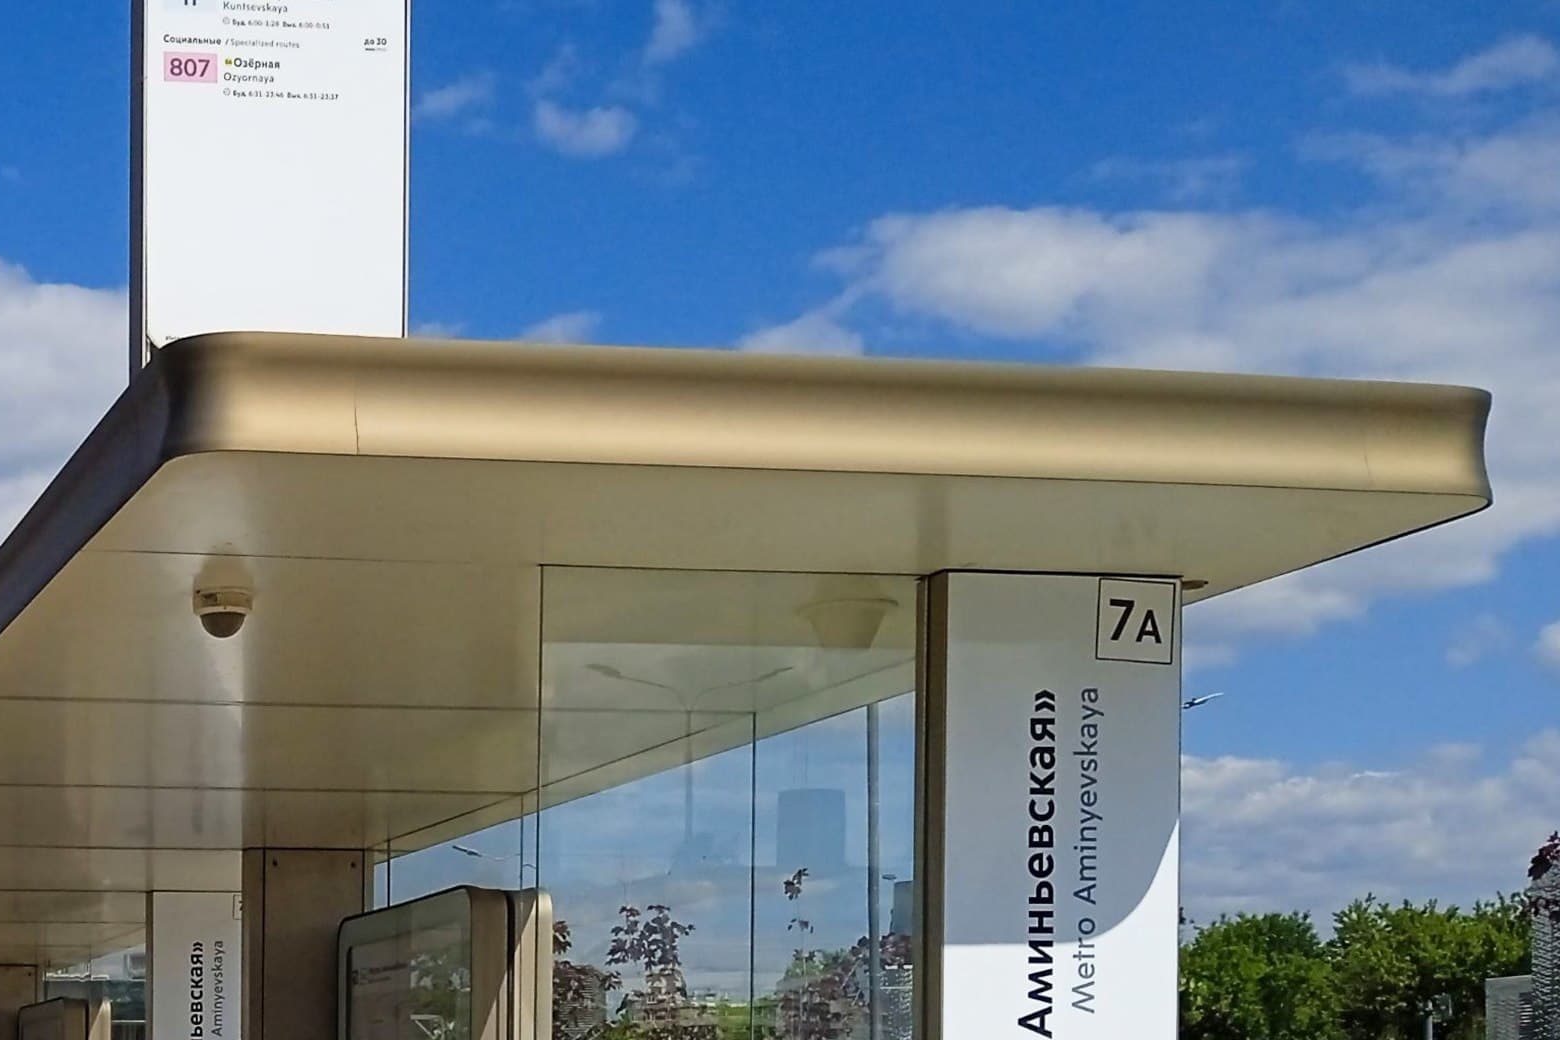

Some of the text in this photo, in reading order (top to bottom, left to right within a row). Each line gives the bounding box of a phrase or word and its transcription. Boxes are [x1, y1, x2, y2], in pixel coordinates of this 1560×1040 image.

[223, 2, 288, 14] Kuntsevskaya
[163, 34, 222, 46] Социальные
[169, 58, 211, 78] 807
[234, 57, 281, 70] Озёрная
[223, 72, 275, 84] Ozyornaya
[1109, 598, 1162, 644] 7А
[1071, 686, 1105, 1014] Metro Aminyevskaya
[211, 939, 226, 1037] Aminyevskaya
